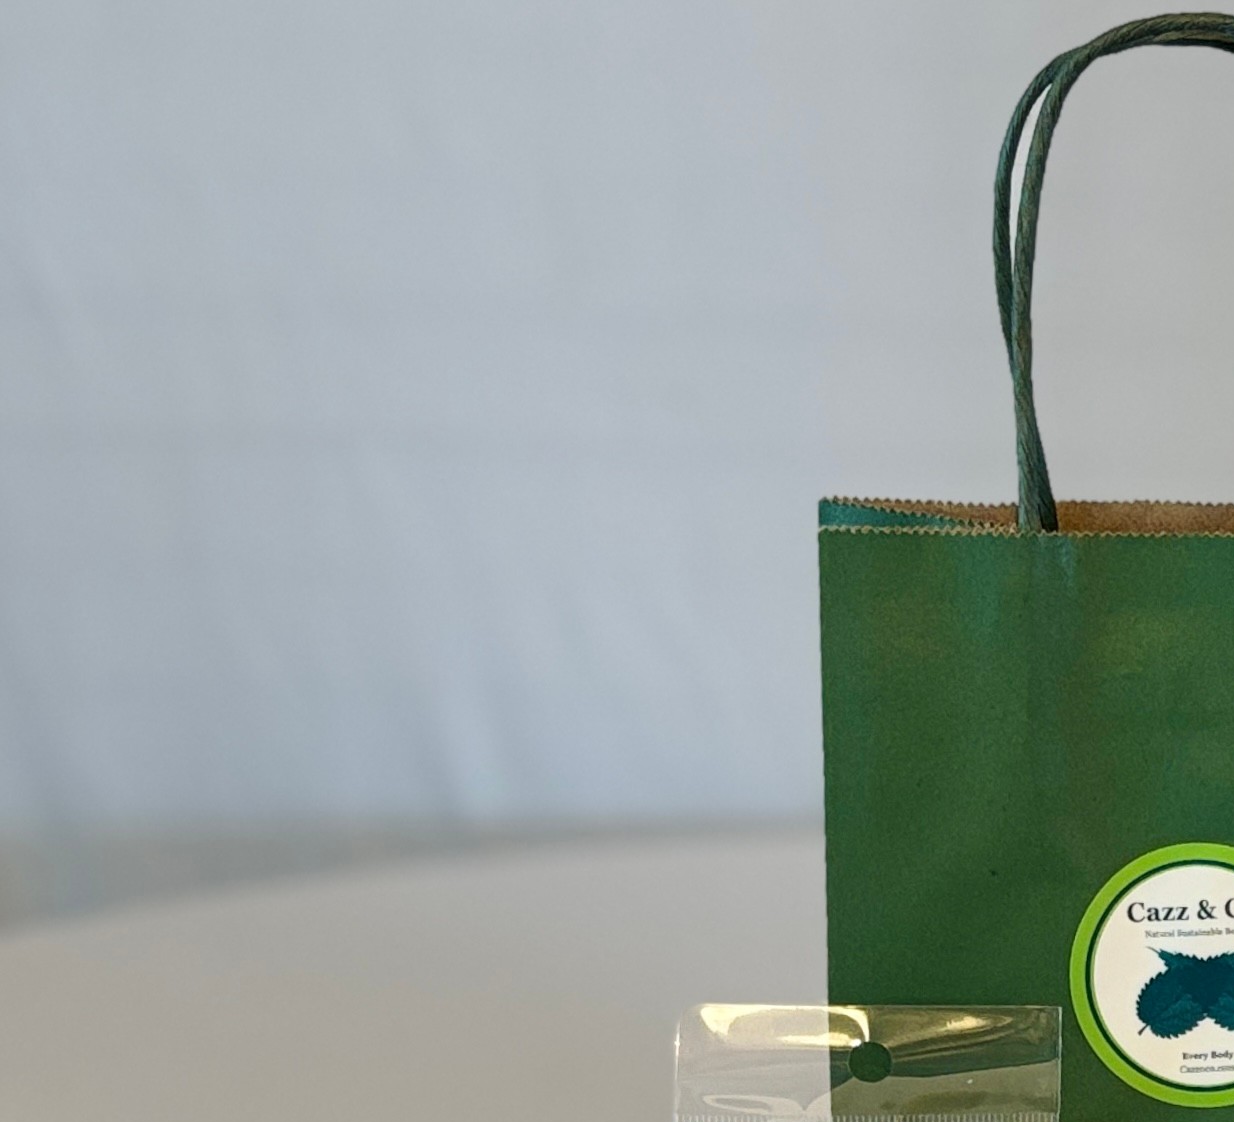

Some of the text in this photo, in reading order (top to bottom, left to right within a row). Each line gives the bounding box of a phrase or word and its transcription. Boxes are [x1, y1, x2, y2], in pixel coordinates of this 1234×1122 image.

[1127, 902, 1190, 922] Cazz
[1197, 900, 1217, 919] &
[1145, 930, 1175, 938] Natural
